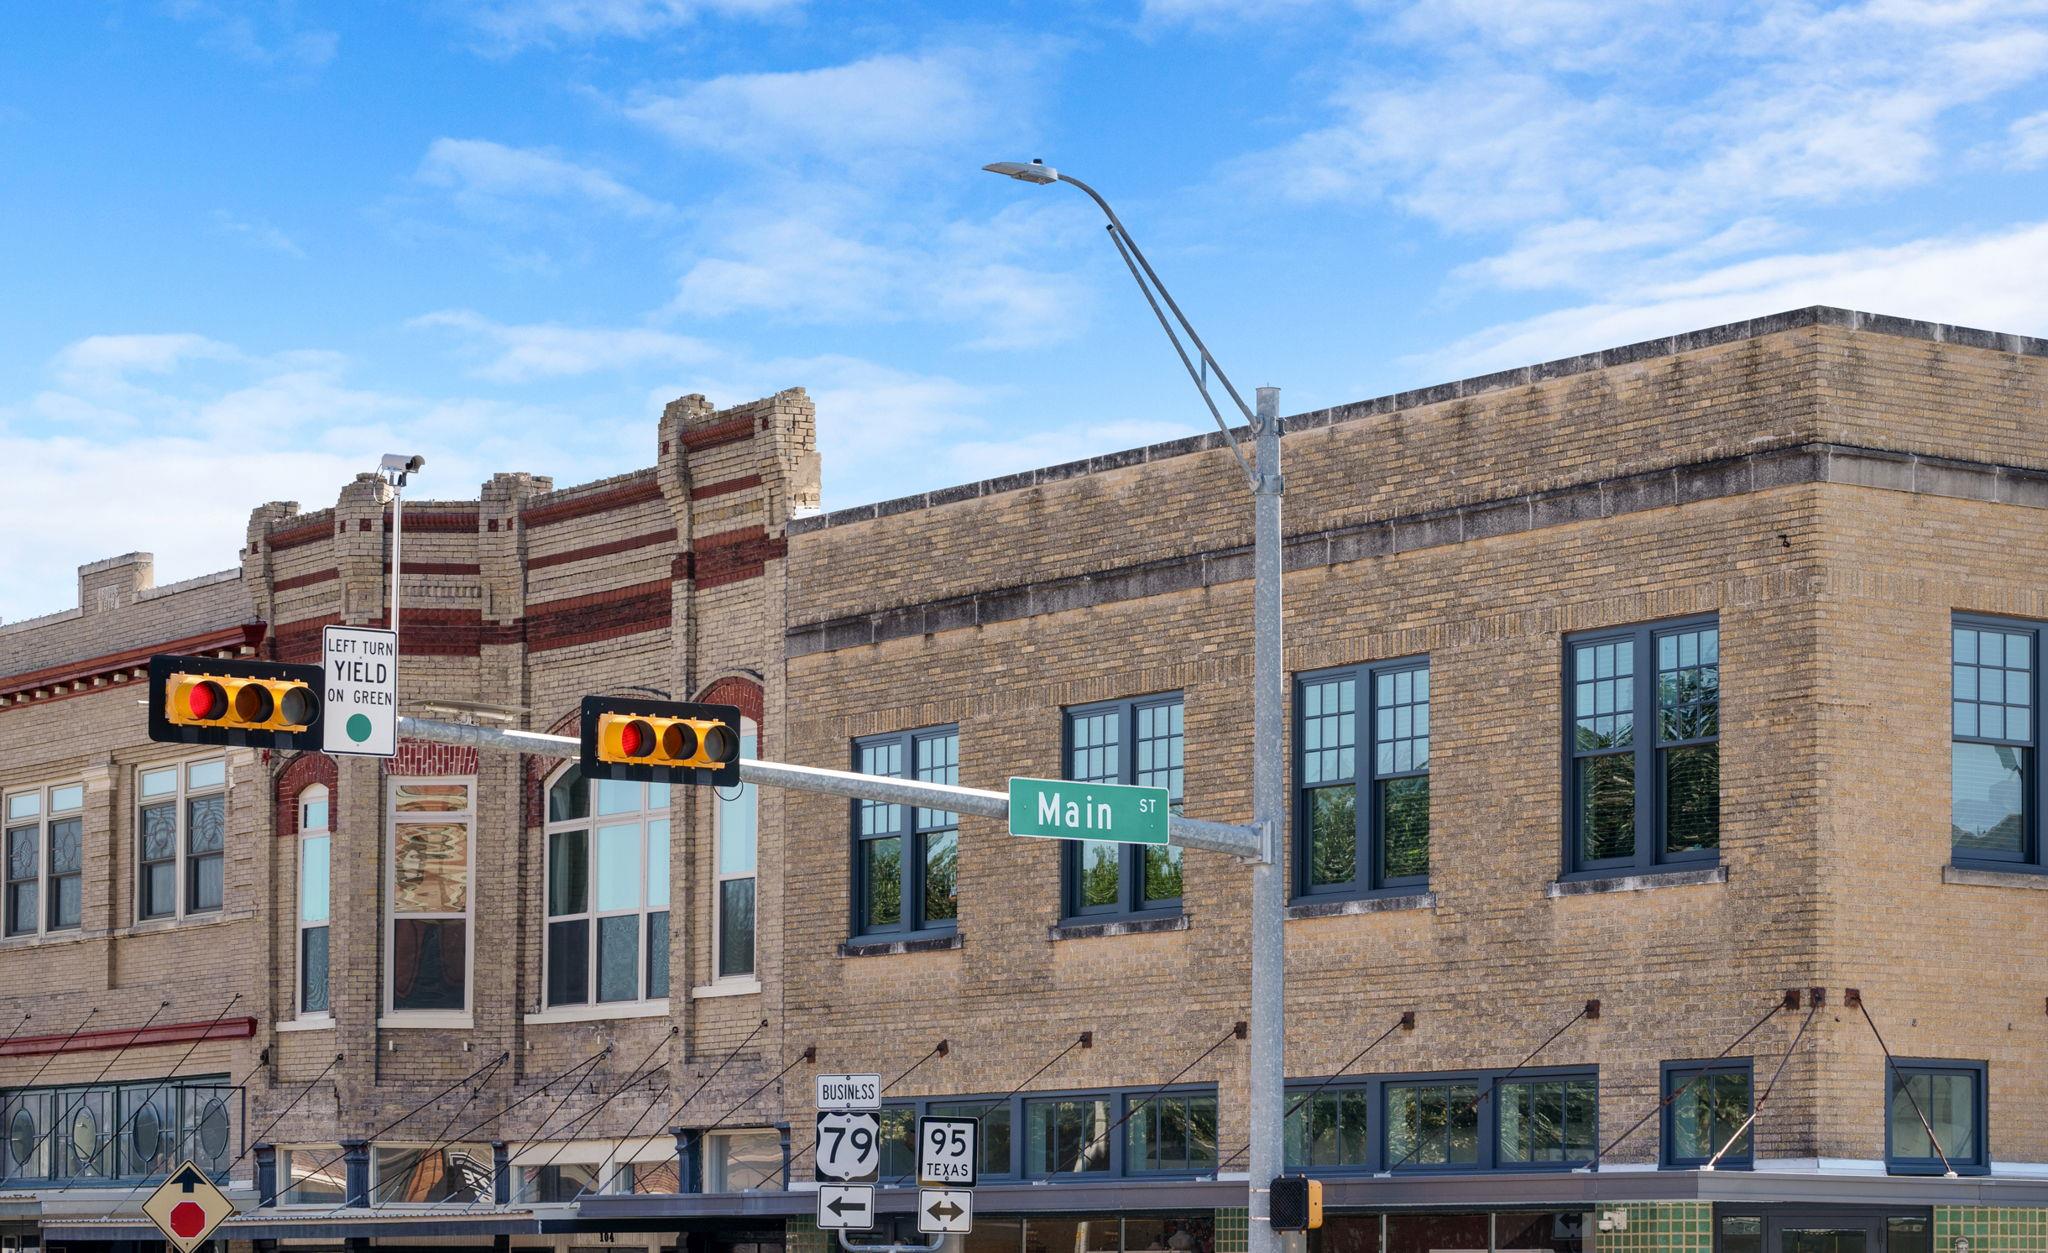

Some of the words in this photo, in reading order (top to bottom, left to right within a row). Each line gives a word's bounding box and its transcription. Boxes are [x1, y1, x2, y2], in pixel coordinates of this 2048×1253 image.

[328, 638, 357, 653] LEFT
[363, 641, 393, 656] TURN
[335, 660, 387, 684] YIELD
[328, 688, 344, 702] ON
[353, 690, 392, 706] GREEN
[1038, 791, 1112, 830] Main
[1139, 799, 1156, 814] ST
[822, 1083, 875, 1100] BUSINESS
[823, 1127, 873, 1164] 79
[931, 1128, 966, 1157] 95
[926, 1163, 969, 1177] TEXAS
